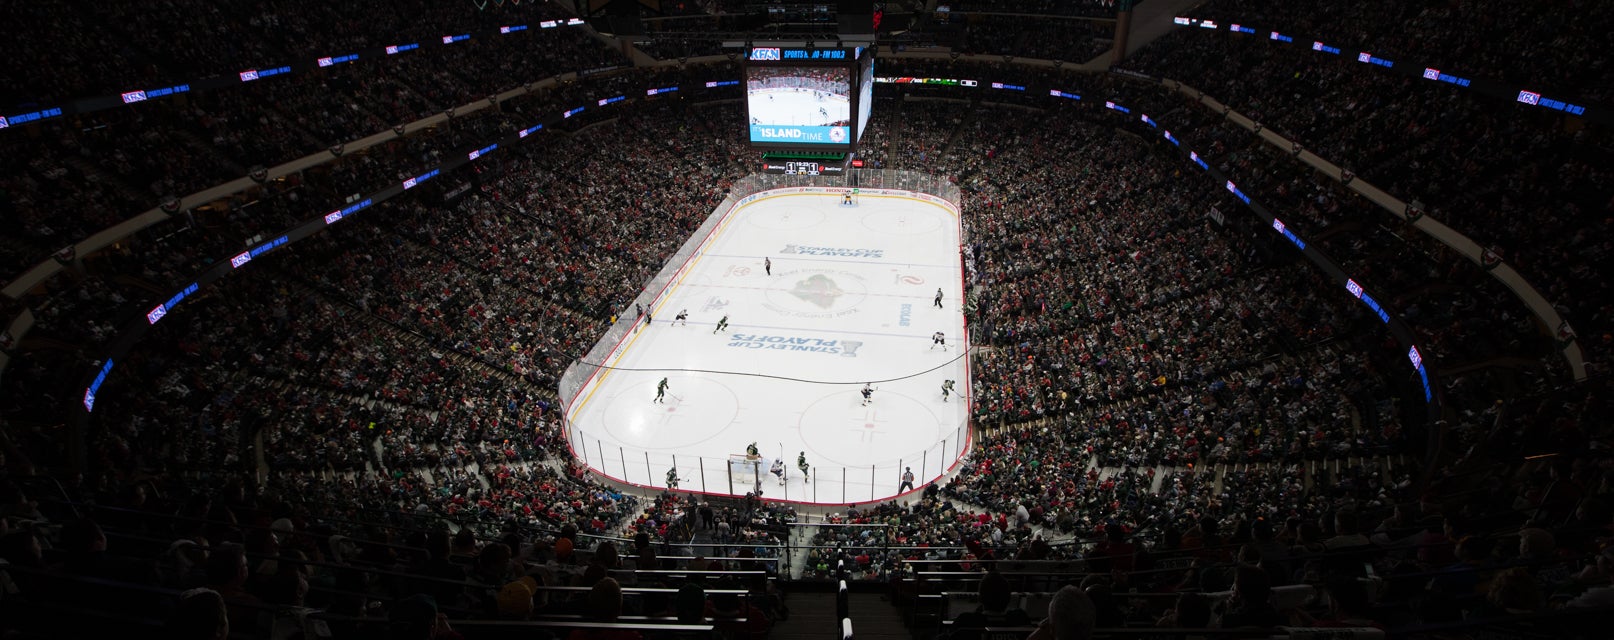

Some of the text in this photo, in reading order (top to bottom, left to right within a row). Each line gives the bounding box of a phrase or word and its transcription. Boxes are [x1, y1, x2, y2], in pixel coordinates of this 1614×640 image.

[750, 48, 780, 60] KFAN
[784, 50, 803, 58] SPORTS
[823, 50, 830, 58] FM
[831, 50, 845, 58] 100.3
[761, 128, 801, 138] ISLAND
[802, 132, 822, 141] TIME
[799, 250, 883, 258] PLAYOFFS
[899, 304, 912, 326] ECOLAB
[730, 333, 838, 347] PLAYOFFS
[728, 341, 841, 354] STANLEY CUP
